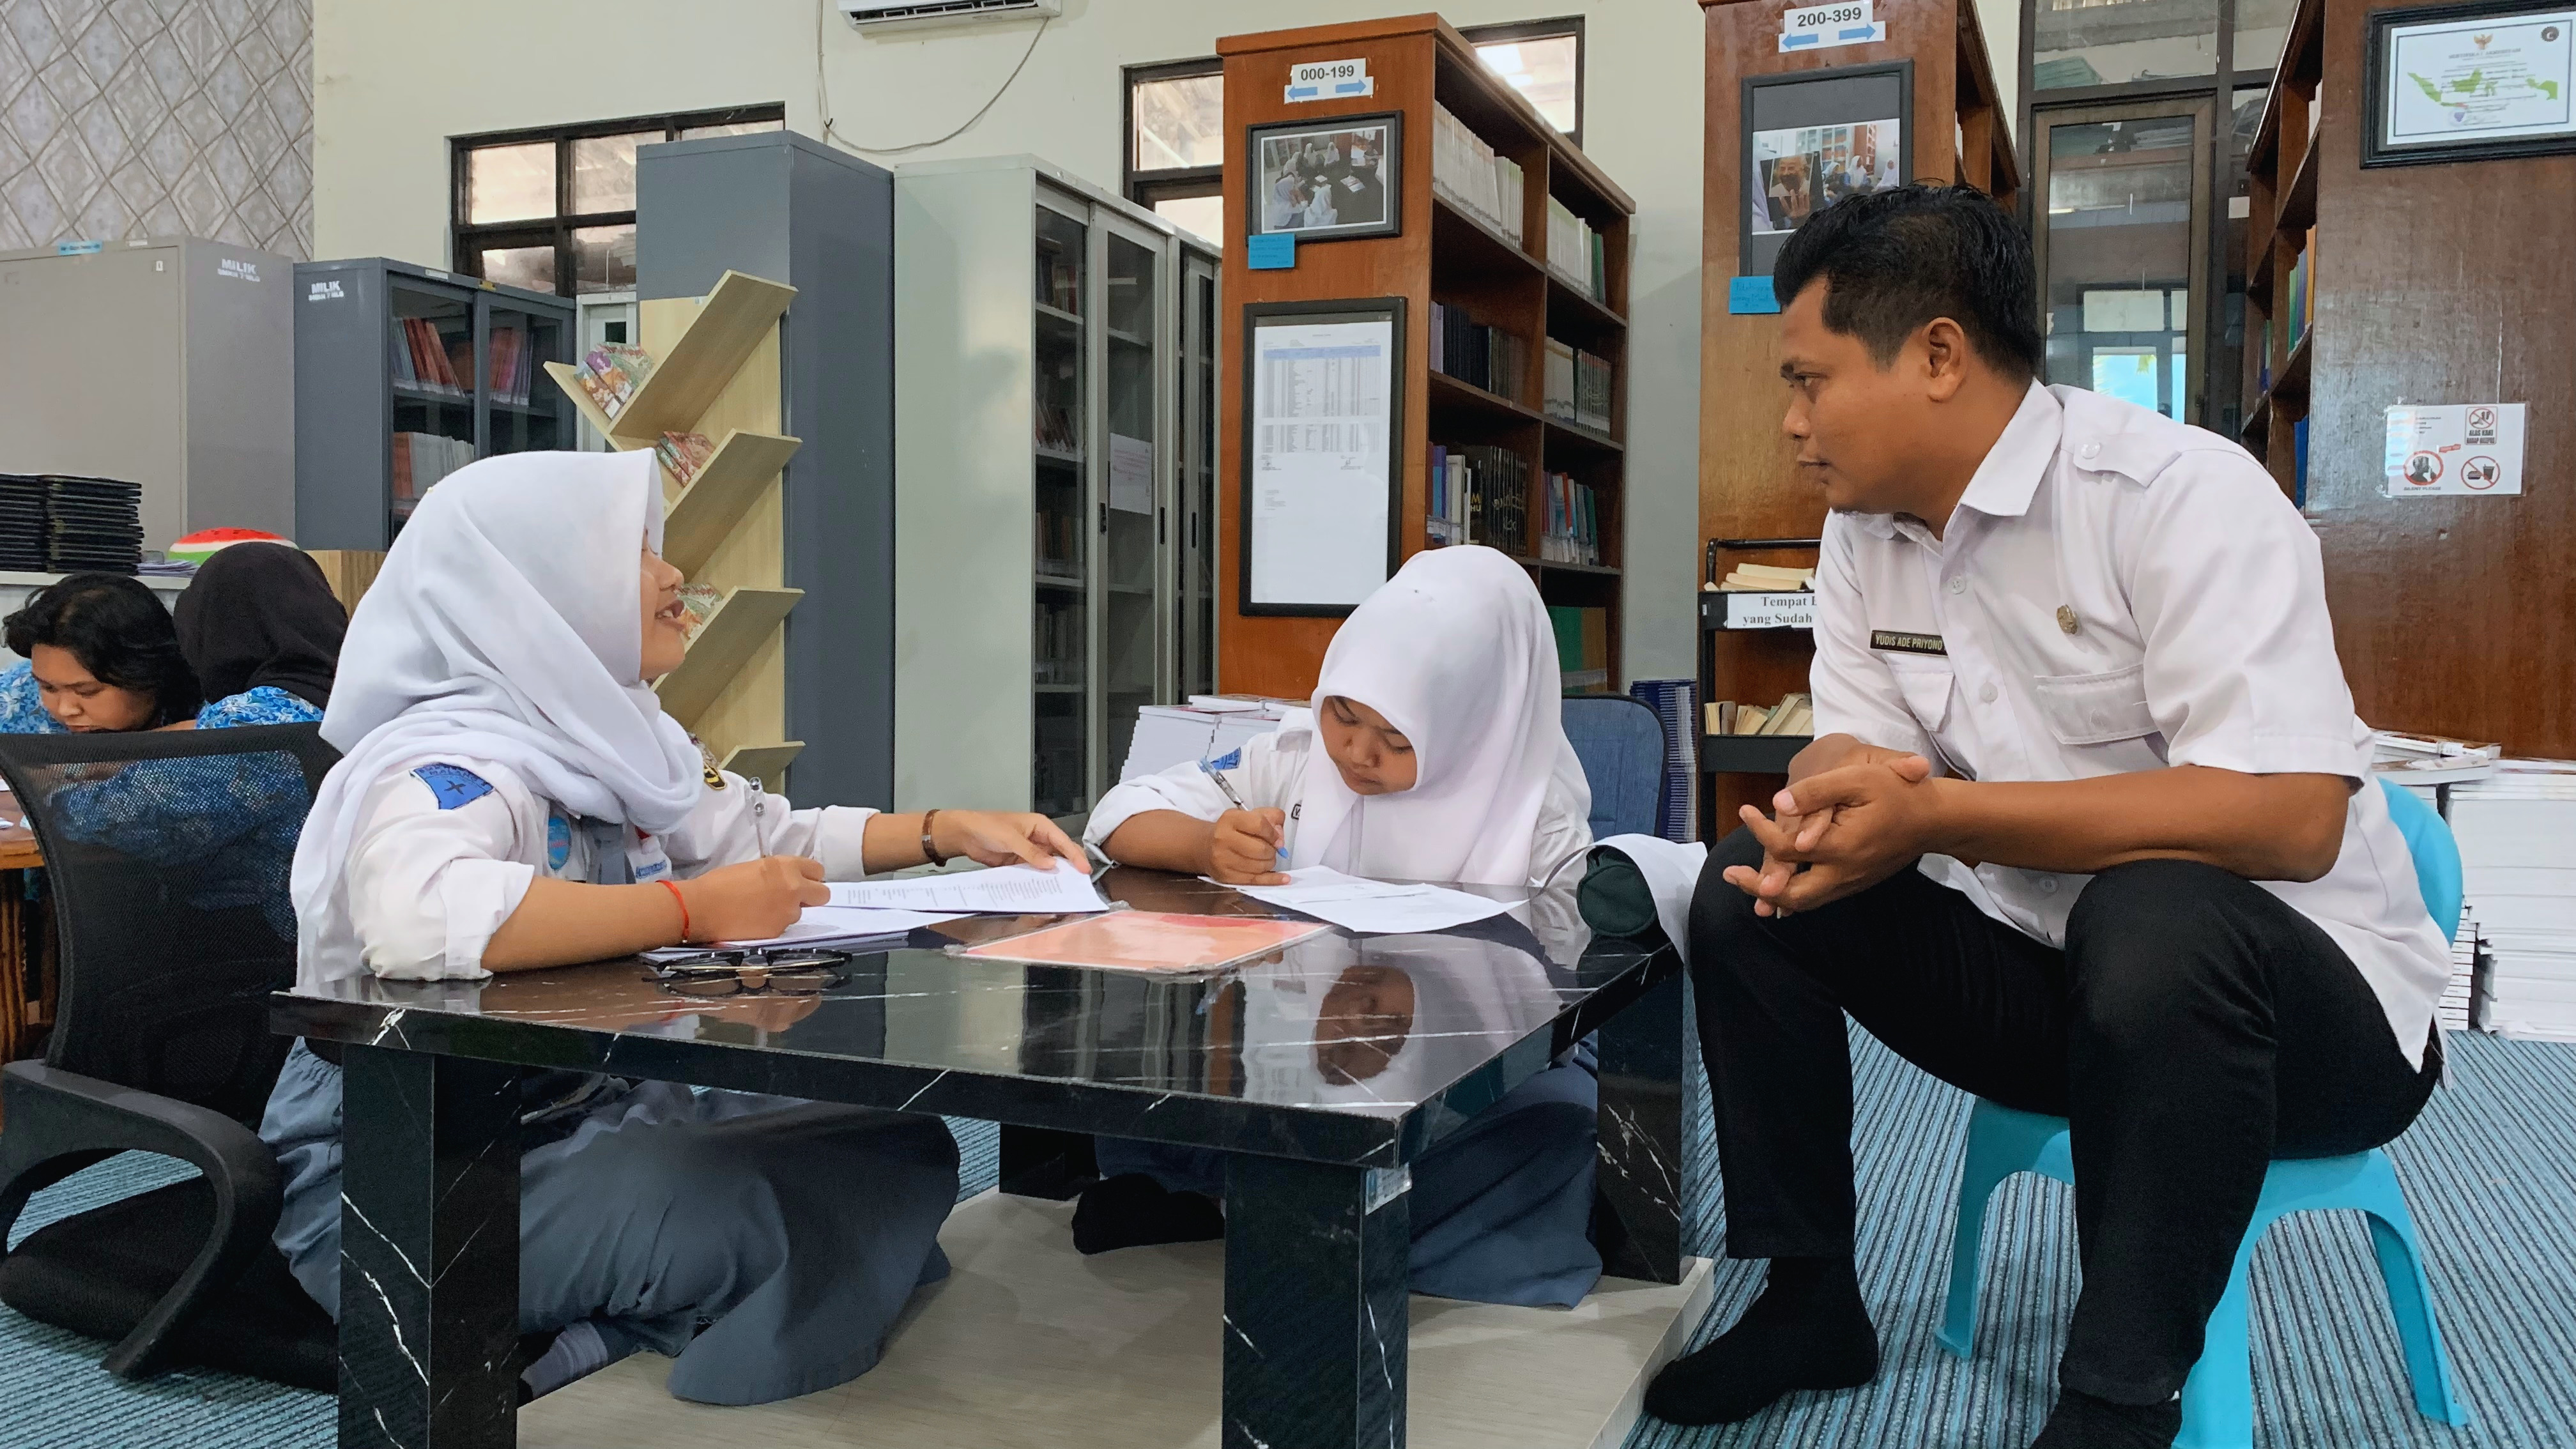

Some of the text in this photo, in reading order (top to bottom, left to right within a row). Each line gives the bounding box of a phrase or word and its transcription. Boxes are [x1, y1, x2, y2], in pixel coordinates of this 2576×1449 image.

[1797, 7, 1862, 27] 200-399
[1301, 65, 1354, 81] 000-199
[221, 258, 257, 275] MILIK
[311, 280, 341, 294] MILIK
[1761, 596, 1807, 609] Tempat
[1743, 613, 1813, 626] yang Sudah
[1875, 634, 1943, 650] YUDIS ADE PRIYONO
